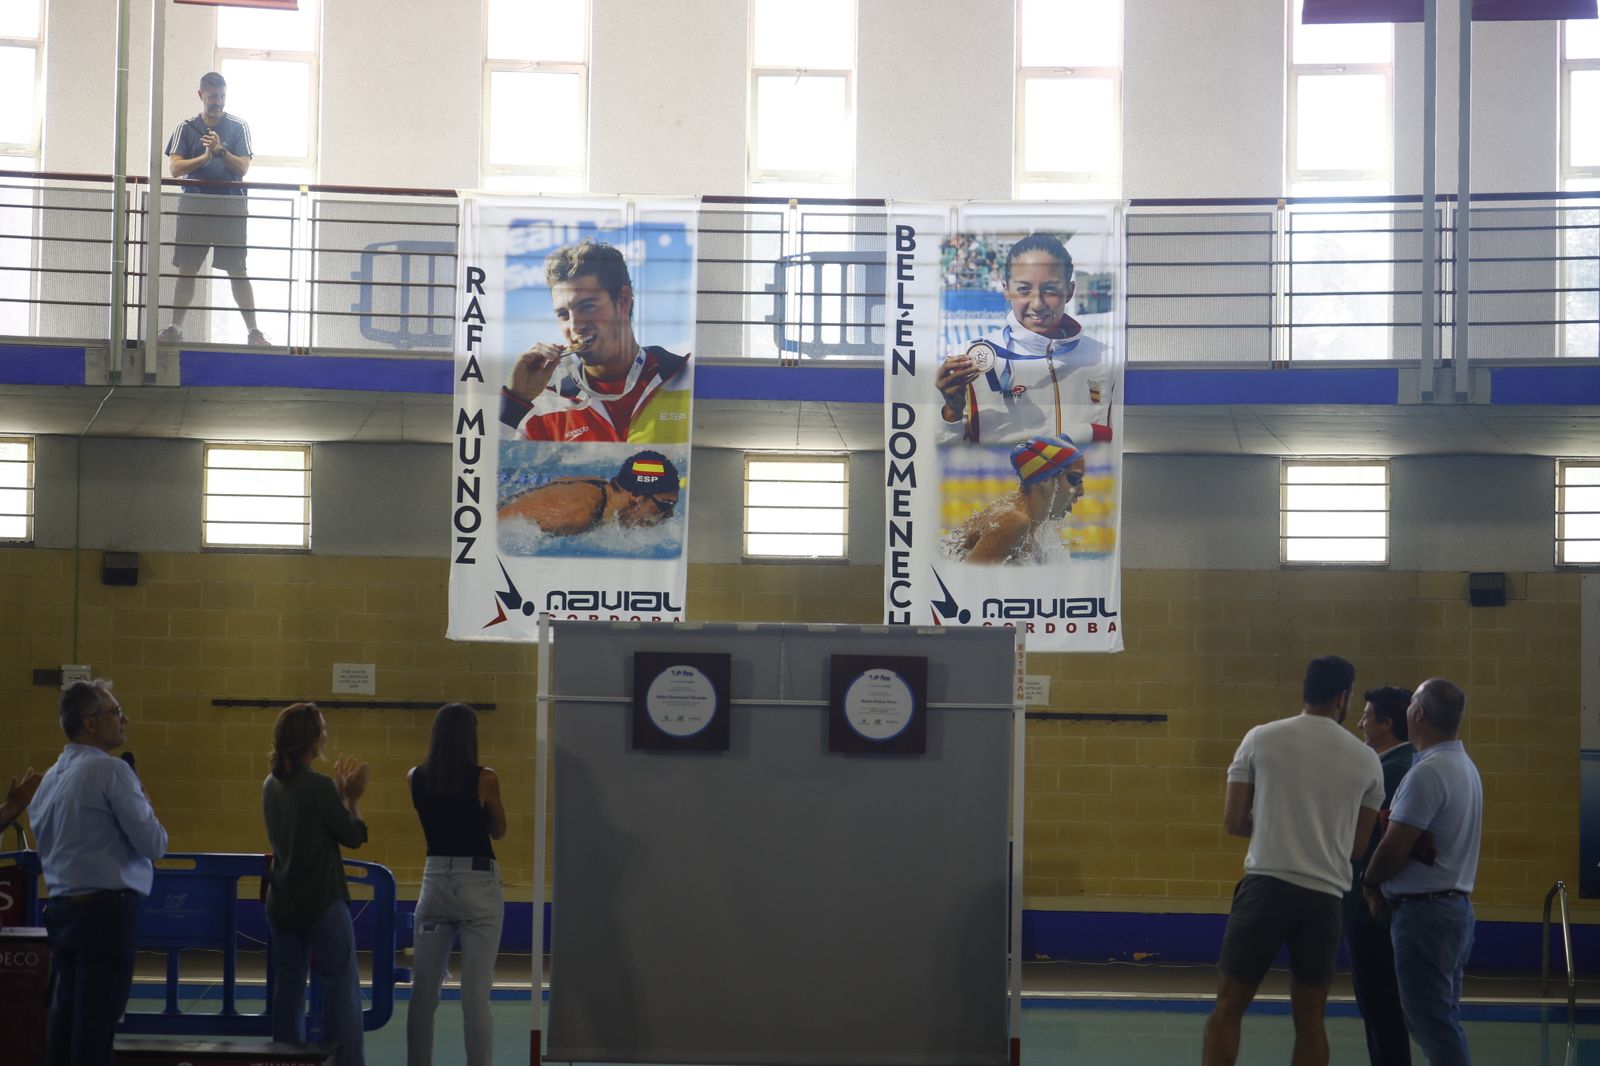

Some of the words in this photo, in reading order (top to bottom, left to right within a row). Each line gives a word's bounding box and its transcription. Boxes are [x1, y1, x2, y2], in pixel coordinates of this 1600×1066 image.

[460, 266, 486, 383] RAFA
[891, 224, 916, 376] BELÉN
[659, 413, 687, 421] ESP
[454, 407, 485, 564] MUÑOZ
[636, 475, 659, 483] ESP
